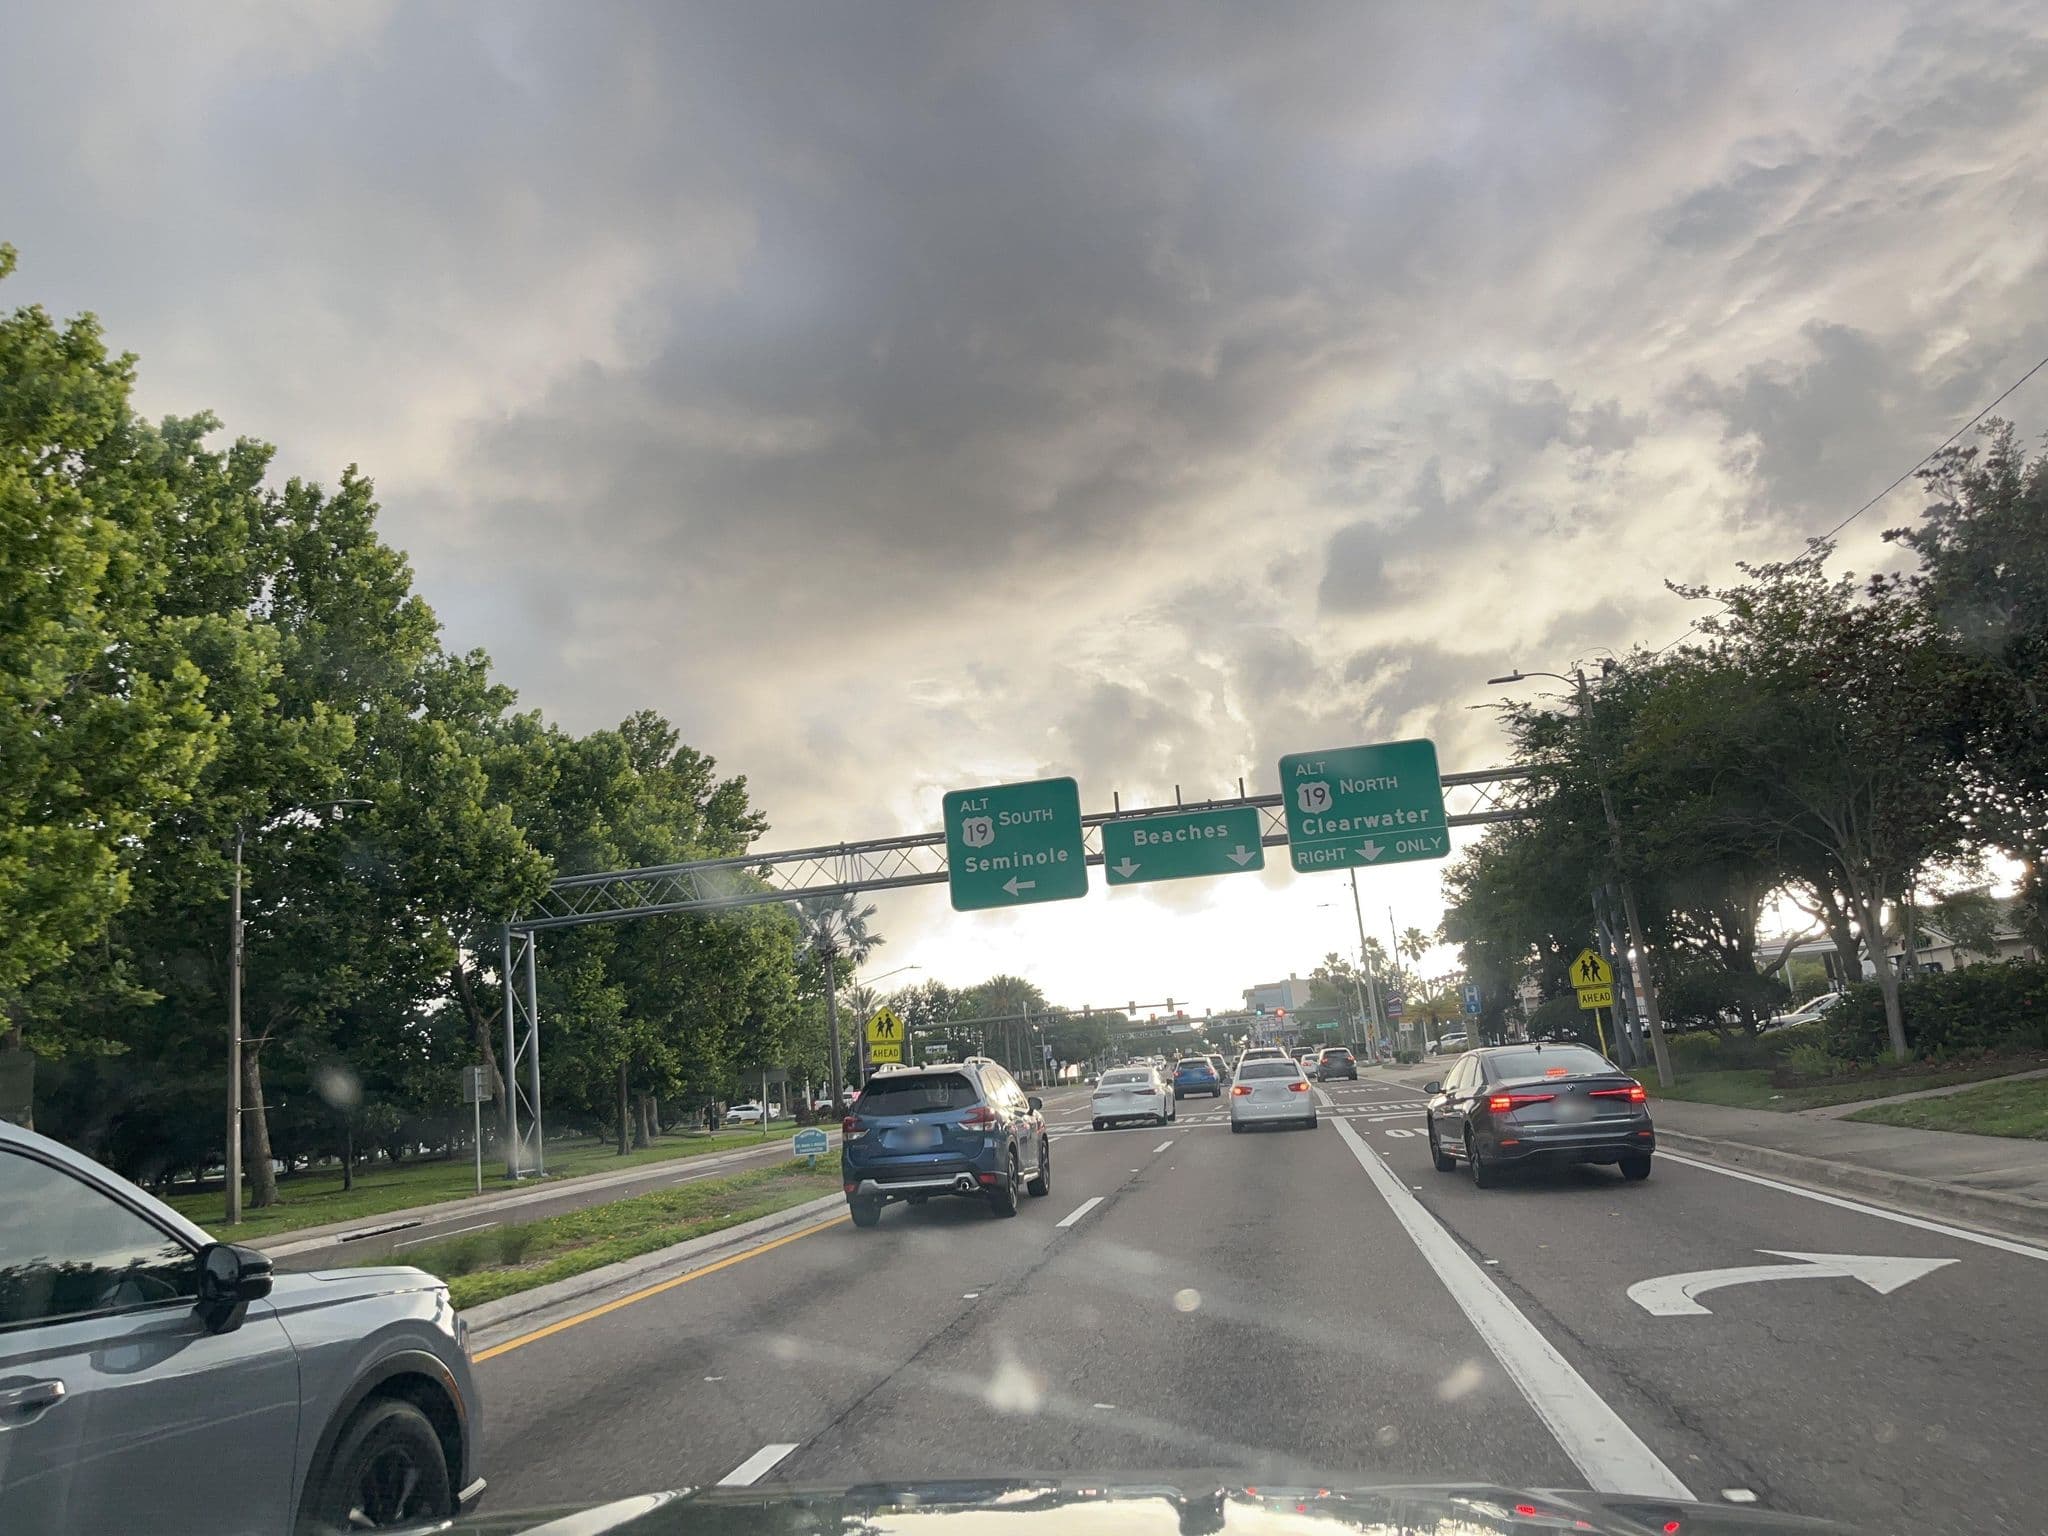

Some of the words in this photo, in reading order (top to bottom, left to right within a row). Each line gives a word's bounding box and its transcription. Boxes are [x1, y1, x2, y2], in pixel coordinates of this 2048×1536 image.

[1296, 762, 1326, 776] ALT
[1340, 776, 1398, 795] NORTH
[960, 798, 989, 813] ALT
[1303, 787, 1326, 807] 19
[998, 808, 1053, 826] SOUTH
[1302, 808, 1430, 835] Clearwater
[967, 823, 988, 842] 19
[1133, 824, 1229, 846] Beaches
[964, 847, 1069, 873] Seminole
[1297, 847, 1347, 865] RIGHT
[1395, 836, 1442, 854] ONLY
[1465, 986, 1478, 1002] H
[1582, 992, 1611, 1004] AHEAD
[872, 1048, 899, 1058] AHEAD
